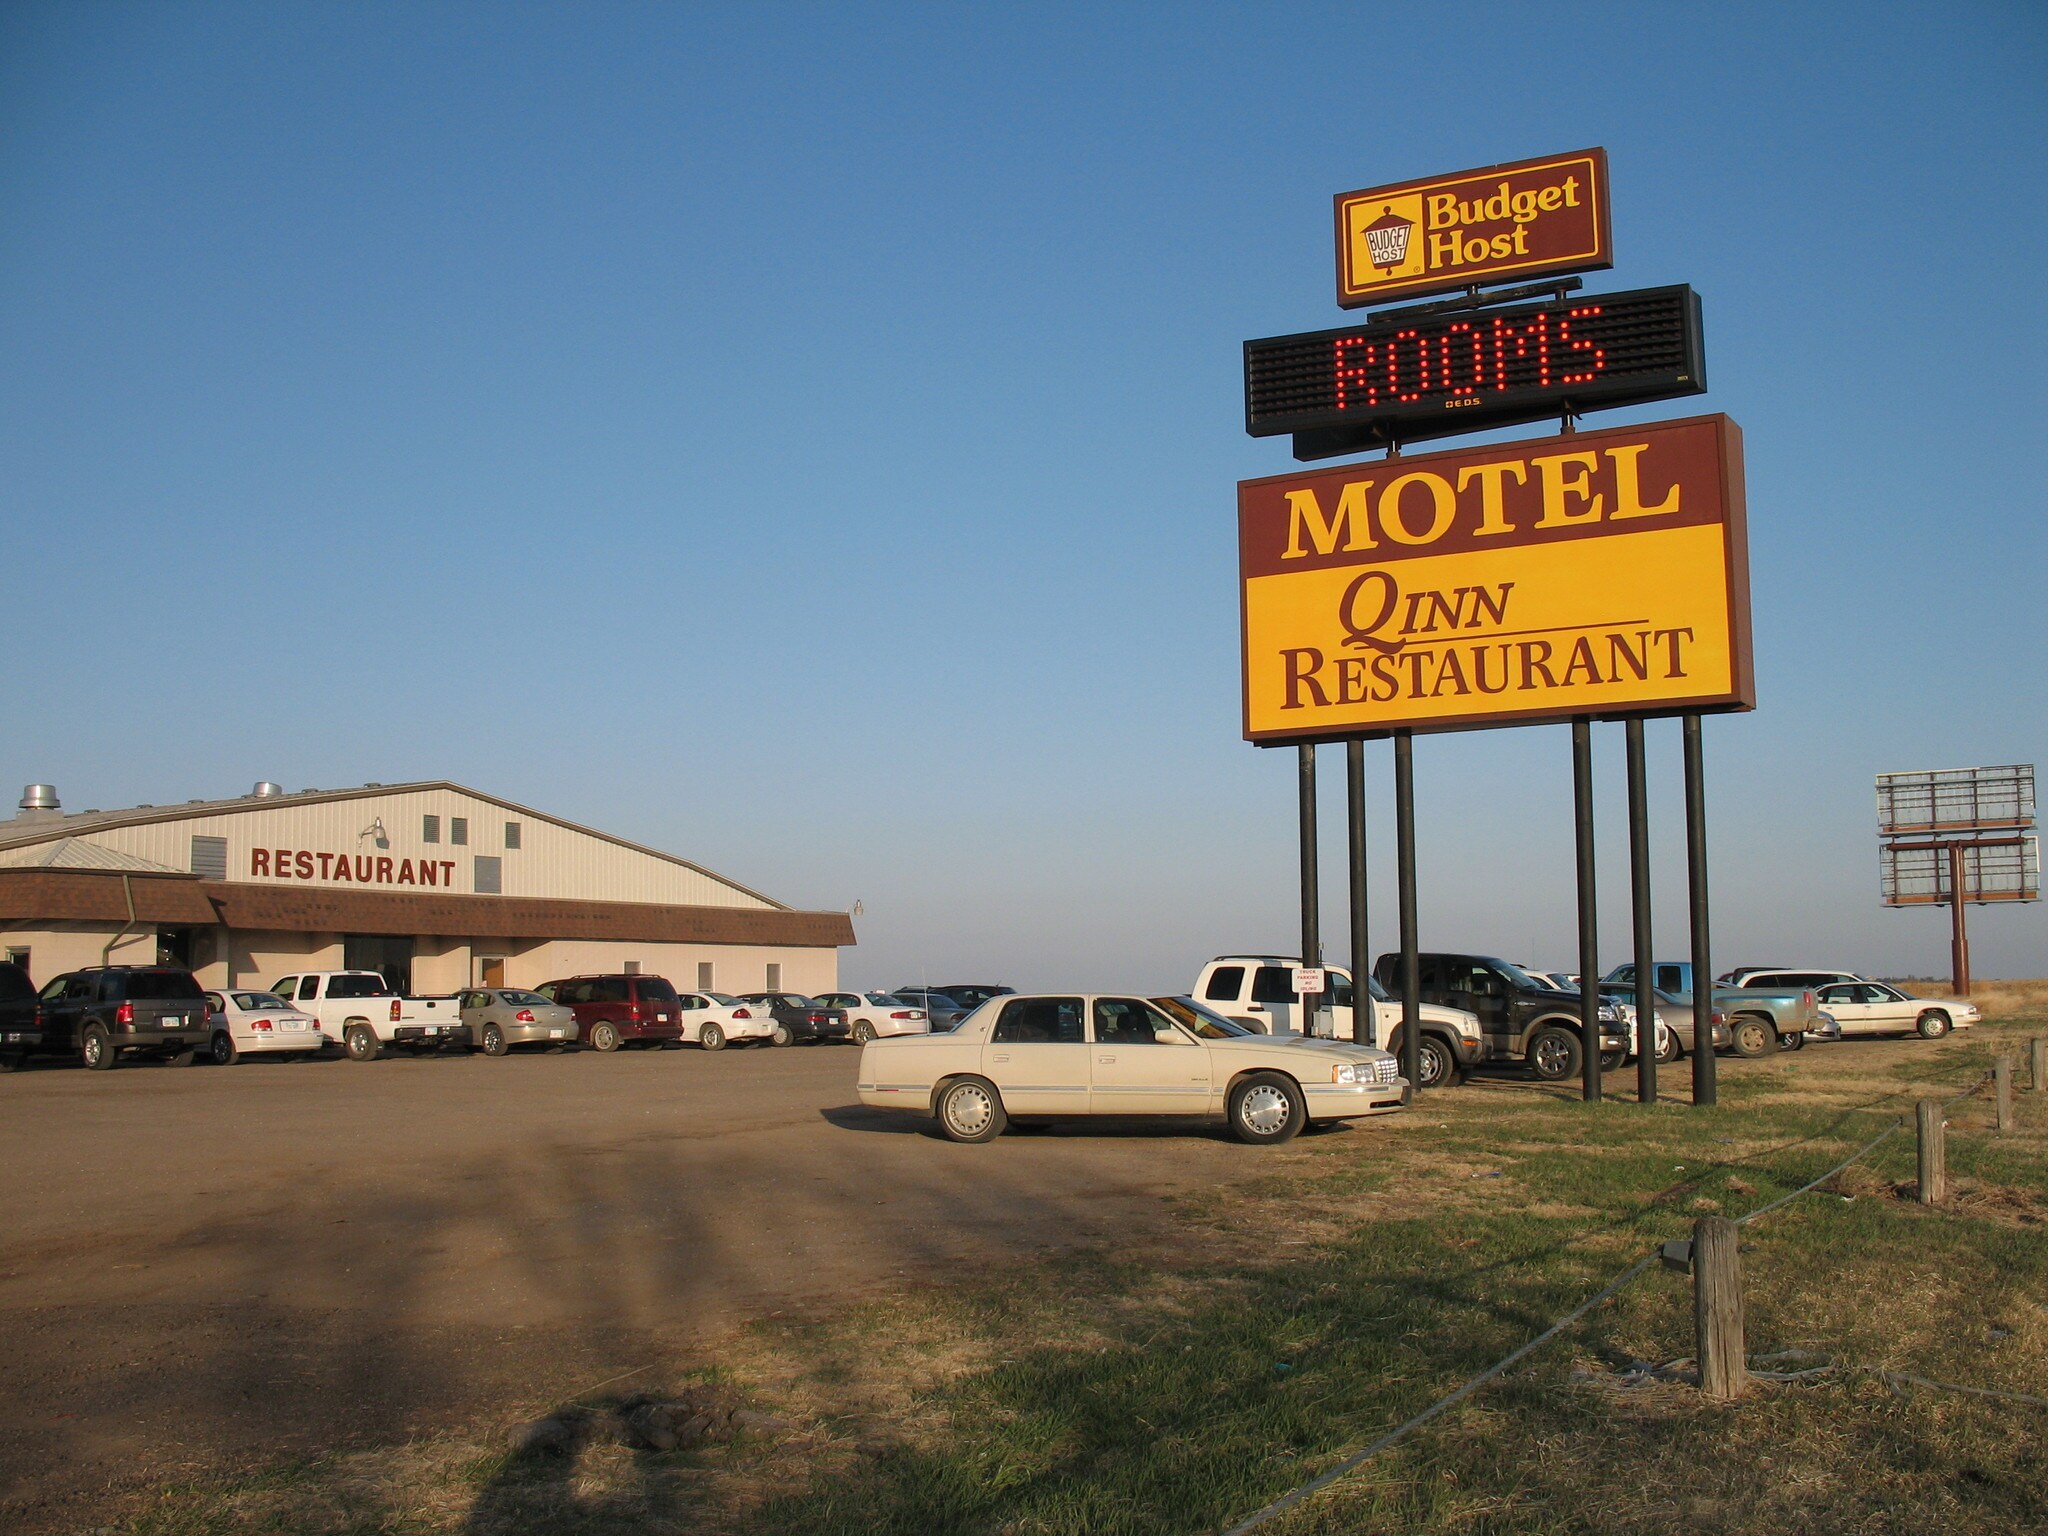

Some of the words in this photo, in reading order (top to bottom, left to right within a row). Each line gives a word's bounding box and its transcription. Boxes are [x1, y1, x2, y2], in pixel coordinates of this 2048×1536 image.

[1426, 175, 1580, 231] Budget
[1368, 226, 1409, 251] BUDGET
[1373, 247, 1405, 262] HOST
[1428, 224, 1530, 270] Host
[1334, 306, 1602, 410] ROOMS
[1280, 443, 1680, 560] MOTEL
[1279, 627, 1695, 710] RESTAURANT
[251, 847, 456, 887] RESTAURANT
